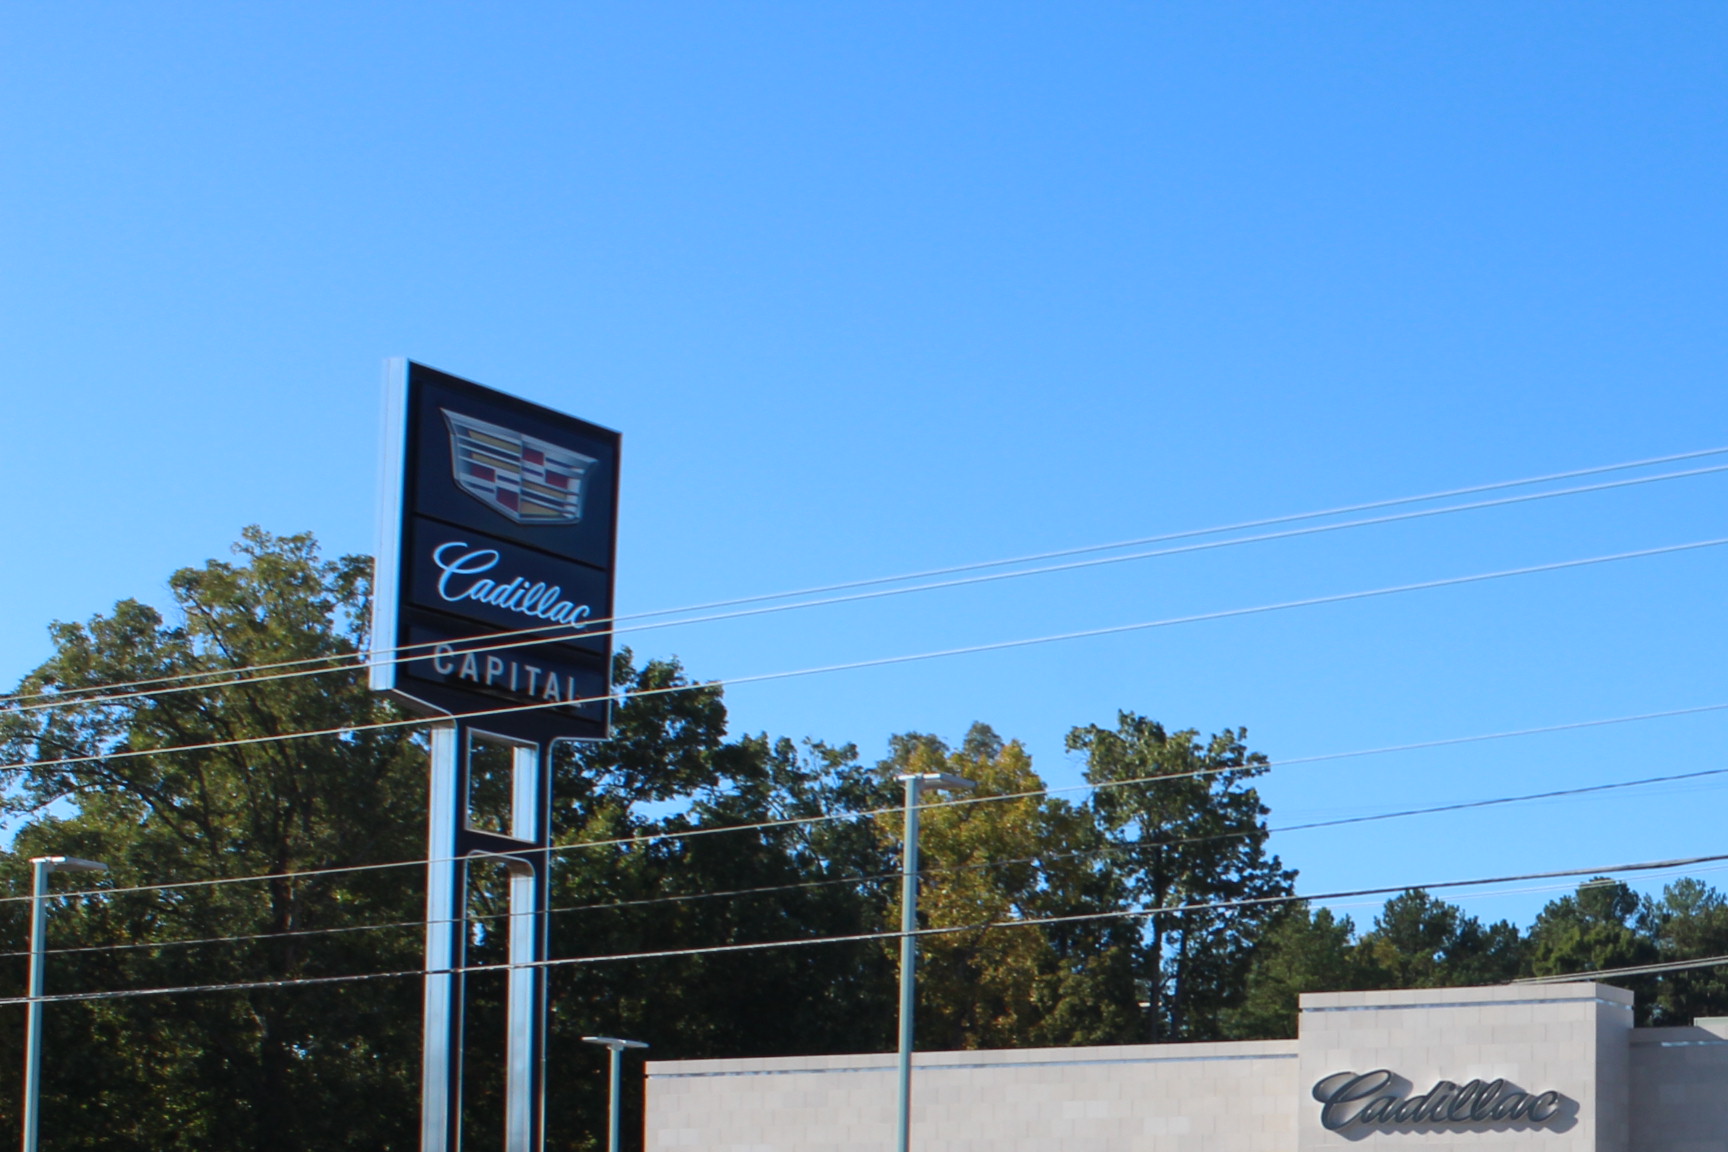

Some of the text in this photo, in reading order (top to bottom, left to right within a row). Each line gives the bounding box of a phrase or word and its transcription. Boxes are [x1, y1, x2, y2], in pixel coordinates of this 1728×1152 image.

[433, 541, 591, 629] Cadillac
[433, 643, 582, 708] CAPITAL
[1312, 1069, 1560, 1131] Cadillac
